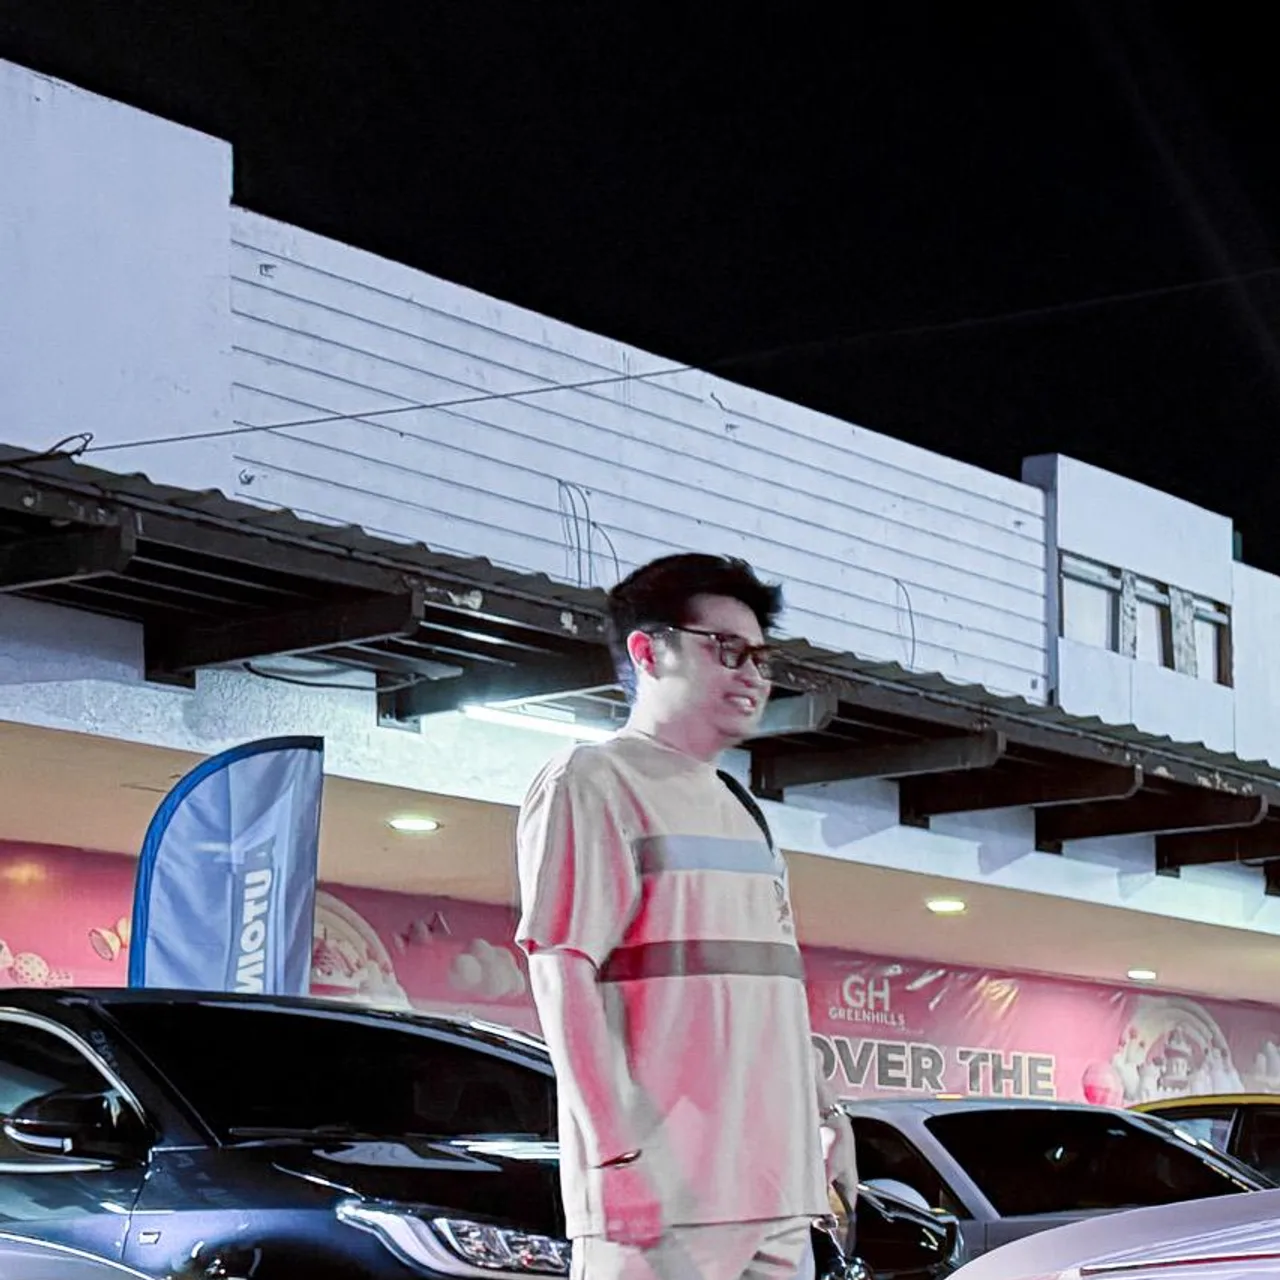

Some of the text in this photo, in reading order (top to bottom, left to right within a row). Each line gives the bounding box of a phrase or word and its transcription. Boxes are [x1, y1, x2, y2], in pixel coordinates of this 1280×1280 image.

[234, 851, 273, 994] MOTU
[842, 974, 890, 1012] GH
[828, 1005, 906, 1027] GREENHILLS
[955, 1046, 1057, 1099] THE
